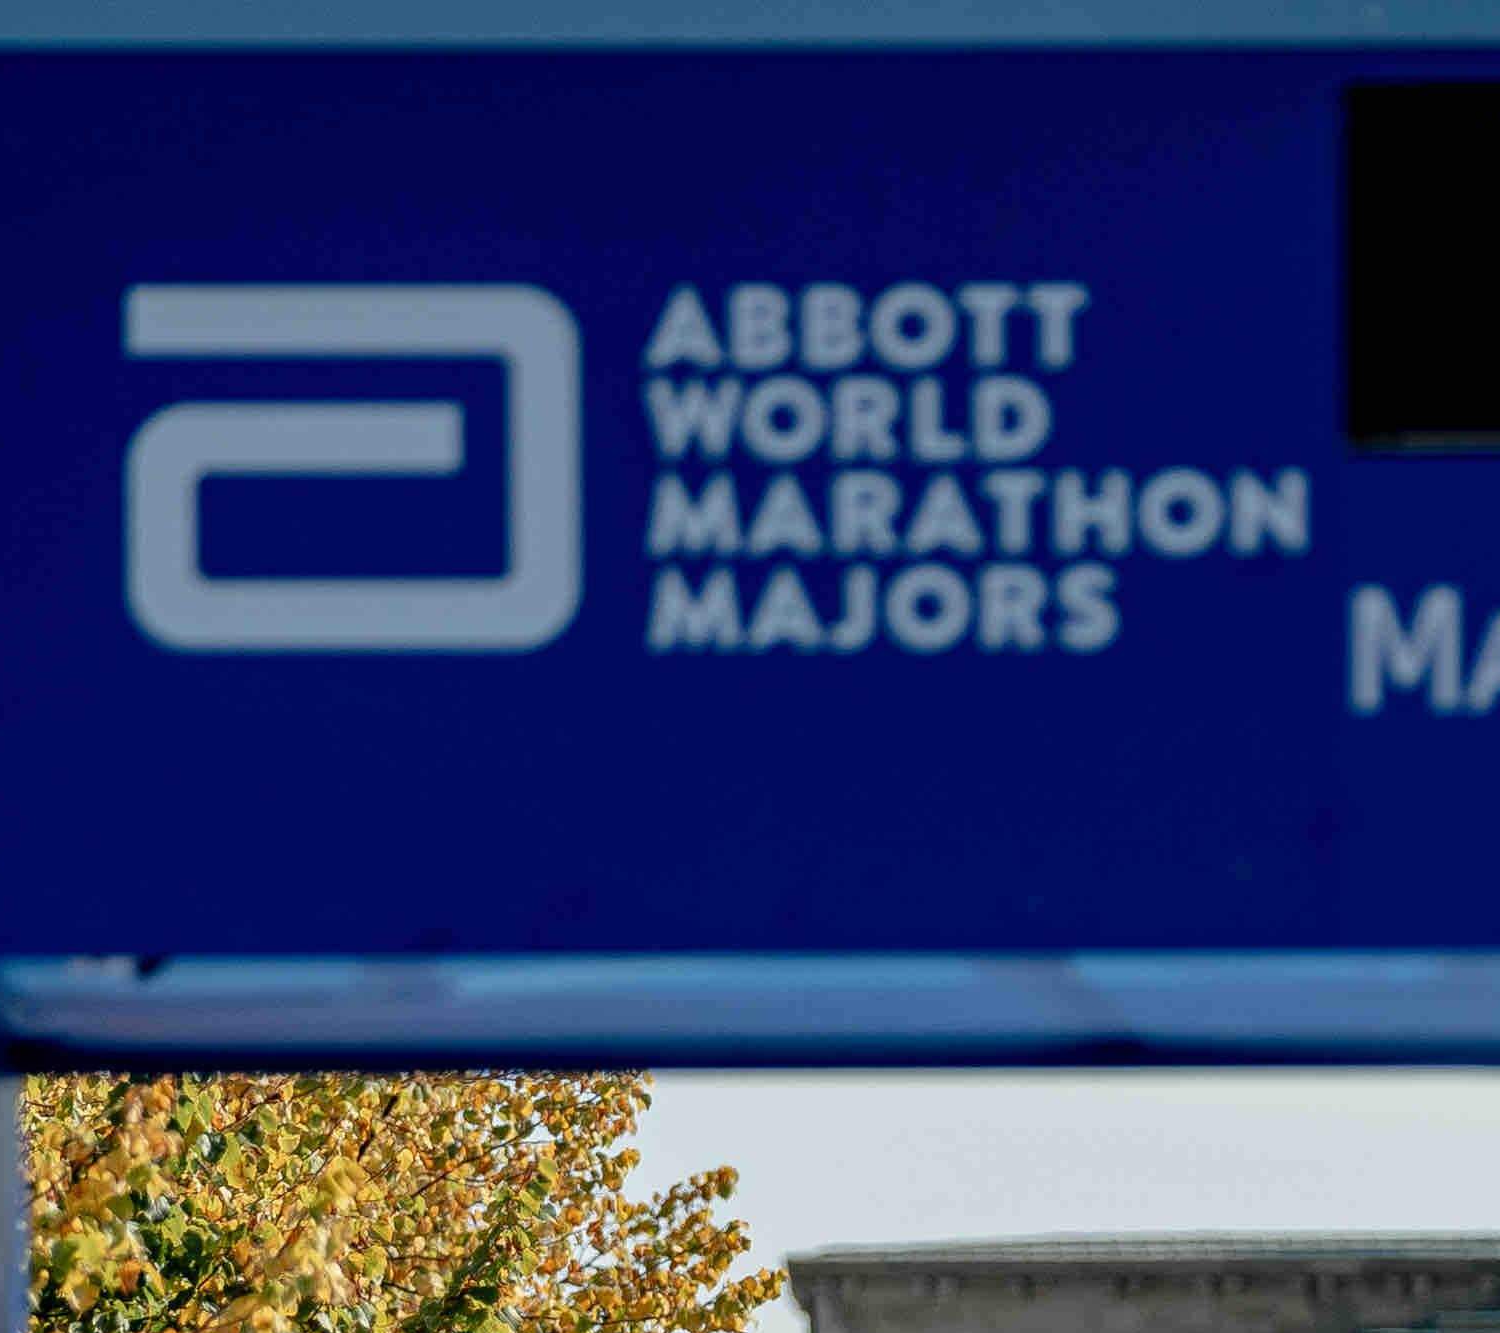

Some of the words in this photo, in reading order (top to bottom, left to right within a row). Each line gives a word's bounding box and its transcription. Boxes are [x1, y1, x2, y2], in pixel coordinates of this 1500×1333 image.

[647, 283, 1088, 370] ABBOTT
[646, 376, 1050, 462] WORLD
[648, 469, 1308, 556] MARATHON
[648, 564, 1118, 651] MAJORS
